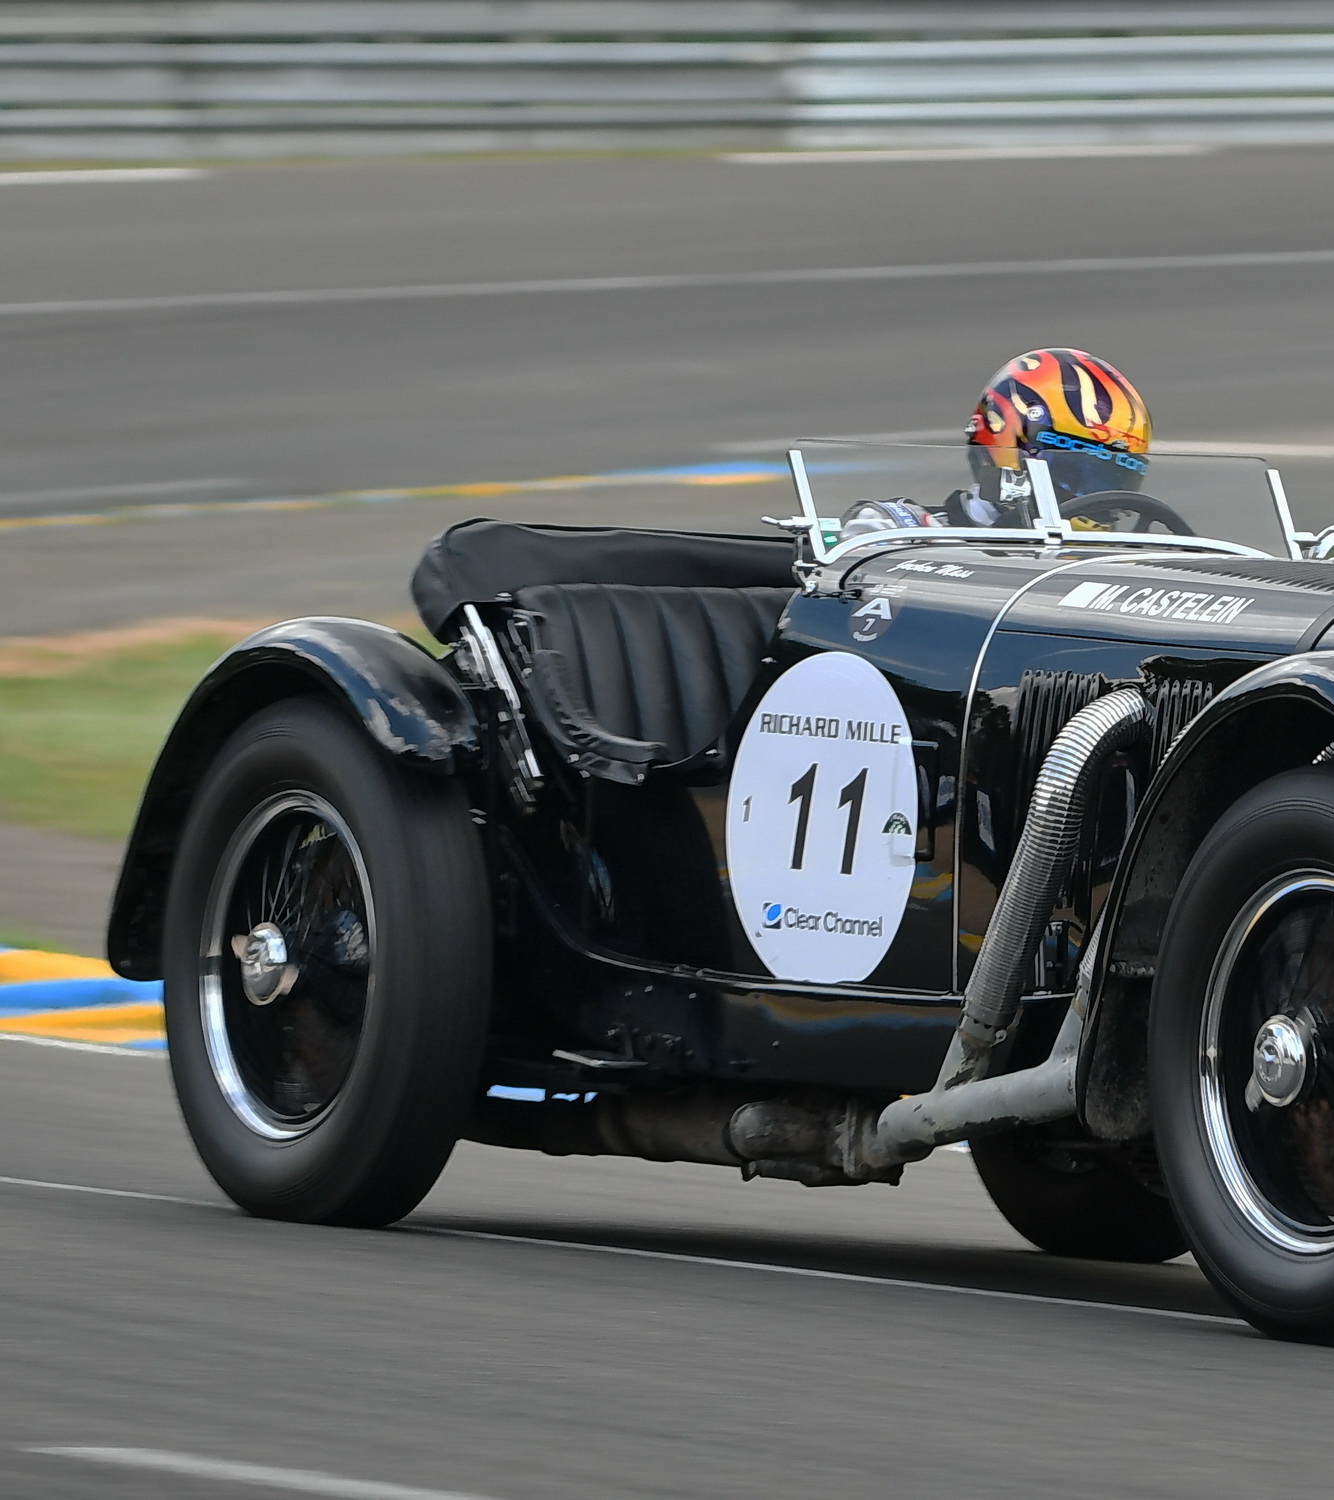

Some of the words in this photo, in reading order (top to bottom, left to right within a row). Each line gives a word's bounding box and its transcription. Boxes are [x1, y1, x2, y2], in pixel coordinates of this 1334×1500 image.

[1089, 584, 1130, 611] M.
[1119, 587, 1255, 624] CASTELEIN
[760, 713, 840, 739] RICHARD
[845, 720, 903, 745] MILLE
[787, 762, 870, 875] 11
[784, 907, 822, 931] Clear
[823, 911, 883, 937] Channel
